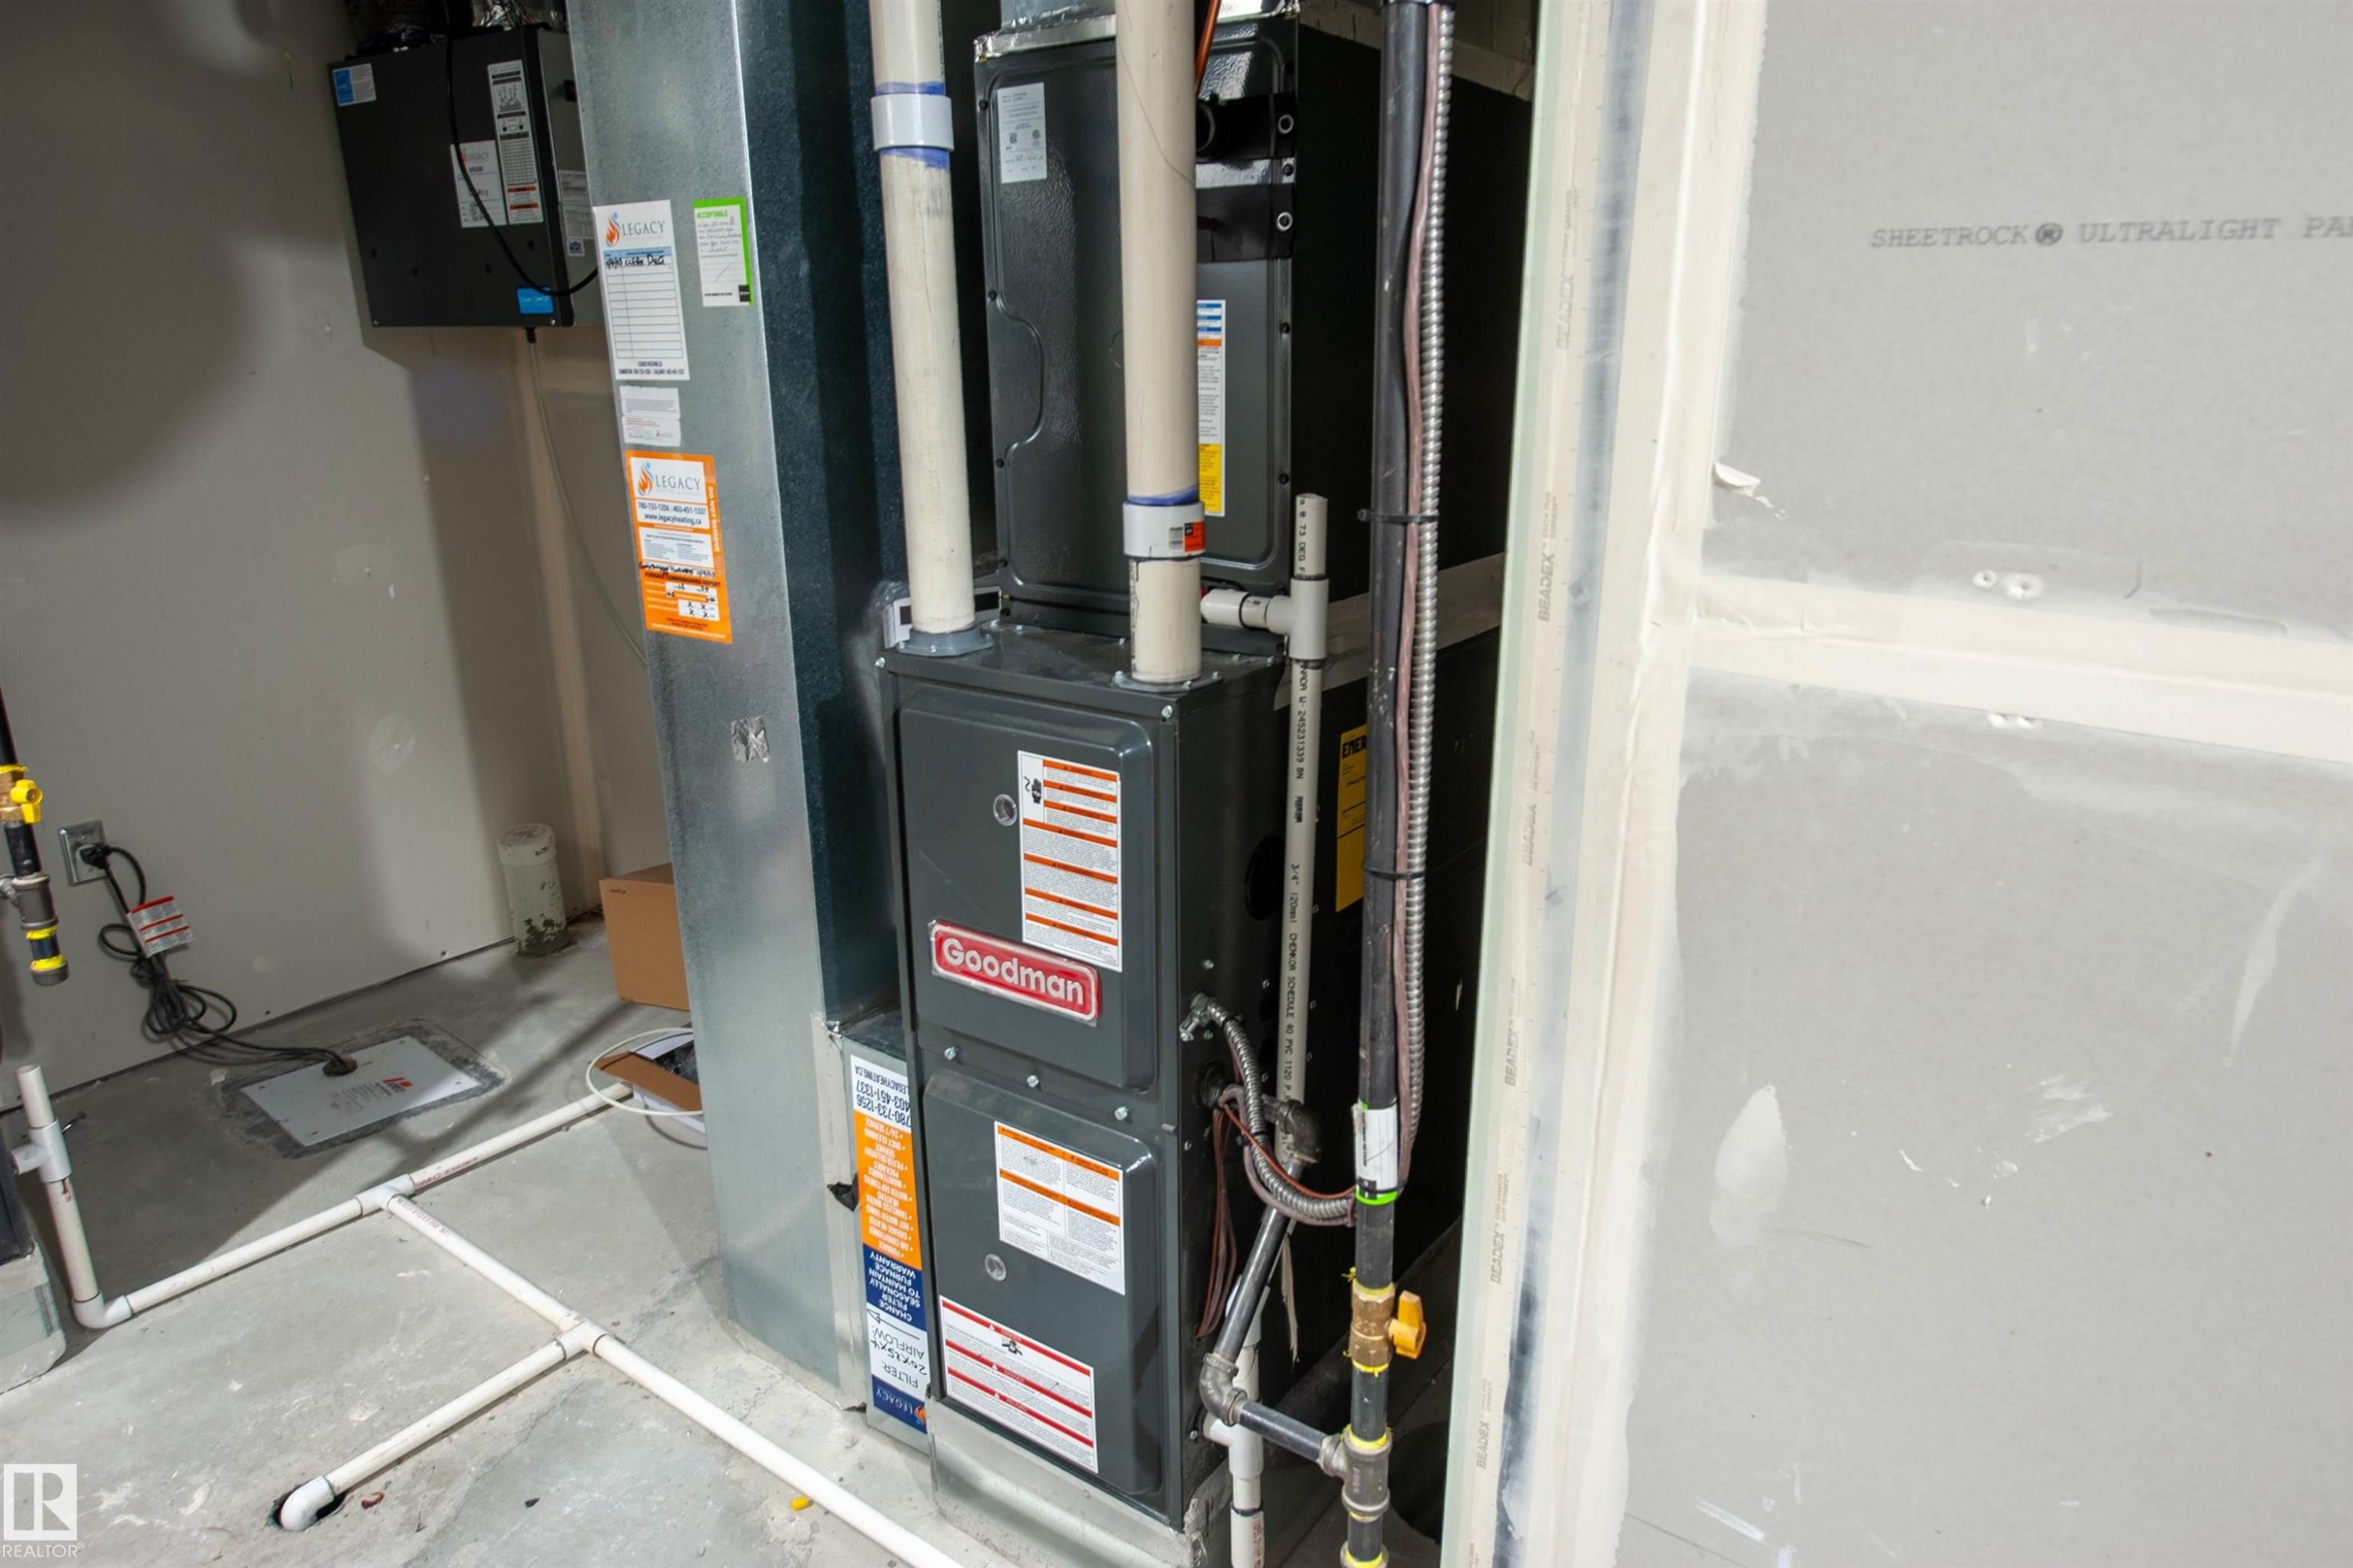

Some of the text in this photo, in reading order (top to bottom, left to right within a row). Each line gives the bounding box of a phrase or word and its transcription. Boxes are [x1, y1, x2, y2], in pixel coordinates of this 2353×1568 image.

[622, 220, 665, 236] LEGACY
[696, 210, 728, 219] ACCEPTABLE
[2079, 217, 2282, 244] ULTRALIGHT
[656, 475, 701, 490] LEGACY
[644, 512, 702, 526] www.legacyheating.ca
[1299, 524, 1307, 537] 73
[711, 519, 720, 552] REMOVE
[1537, 551, 1555, 622] BEADEX
[1288, 932, 1297, 972] CHEMKOR
[943, 937, 1084, 1006] Goodman
[1286, 976, 1296, 1018] SCHEDULE
[1286, 1024, 1294, 1035] 40
[1285, 1039, 1293, 1055] PVC
[1504, 1026, 1520, 1087] BEADEX
[1283, 1060, 1293, 1081] 1120
[855, 1079, 910, 1112] 403-451-1337
[856, 1094, 911, 1127] 780-733-1256
[869, 1250, 915, 1278] WARRANTY
[1490, 1229, 1505, 1285] BEADEX
[867, 1268, 920, 1299] TO MAINTAIN
[874, 1262, 911, 1284] FURNACE
[868, 1277, 920, 1308] SEASONALLY
[882, 1291, 907, 1311] FILTER
[878, 1298, 912, 1322] CHANGE
[871, 1326, 924, 1361] AIRFLOW:
[881, 1362, 918, 1388] FILTER:
[875, 1388, 912, 1414] LEGACY
[1476, 1419, 1490, 1470] BEADEX
